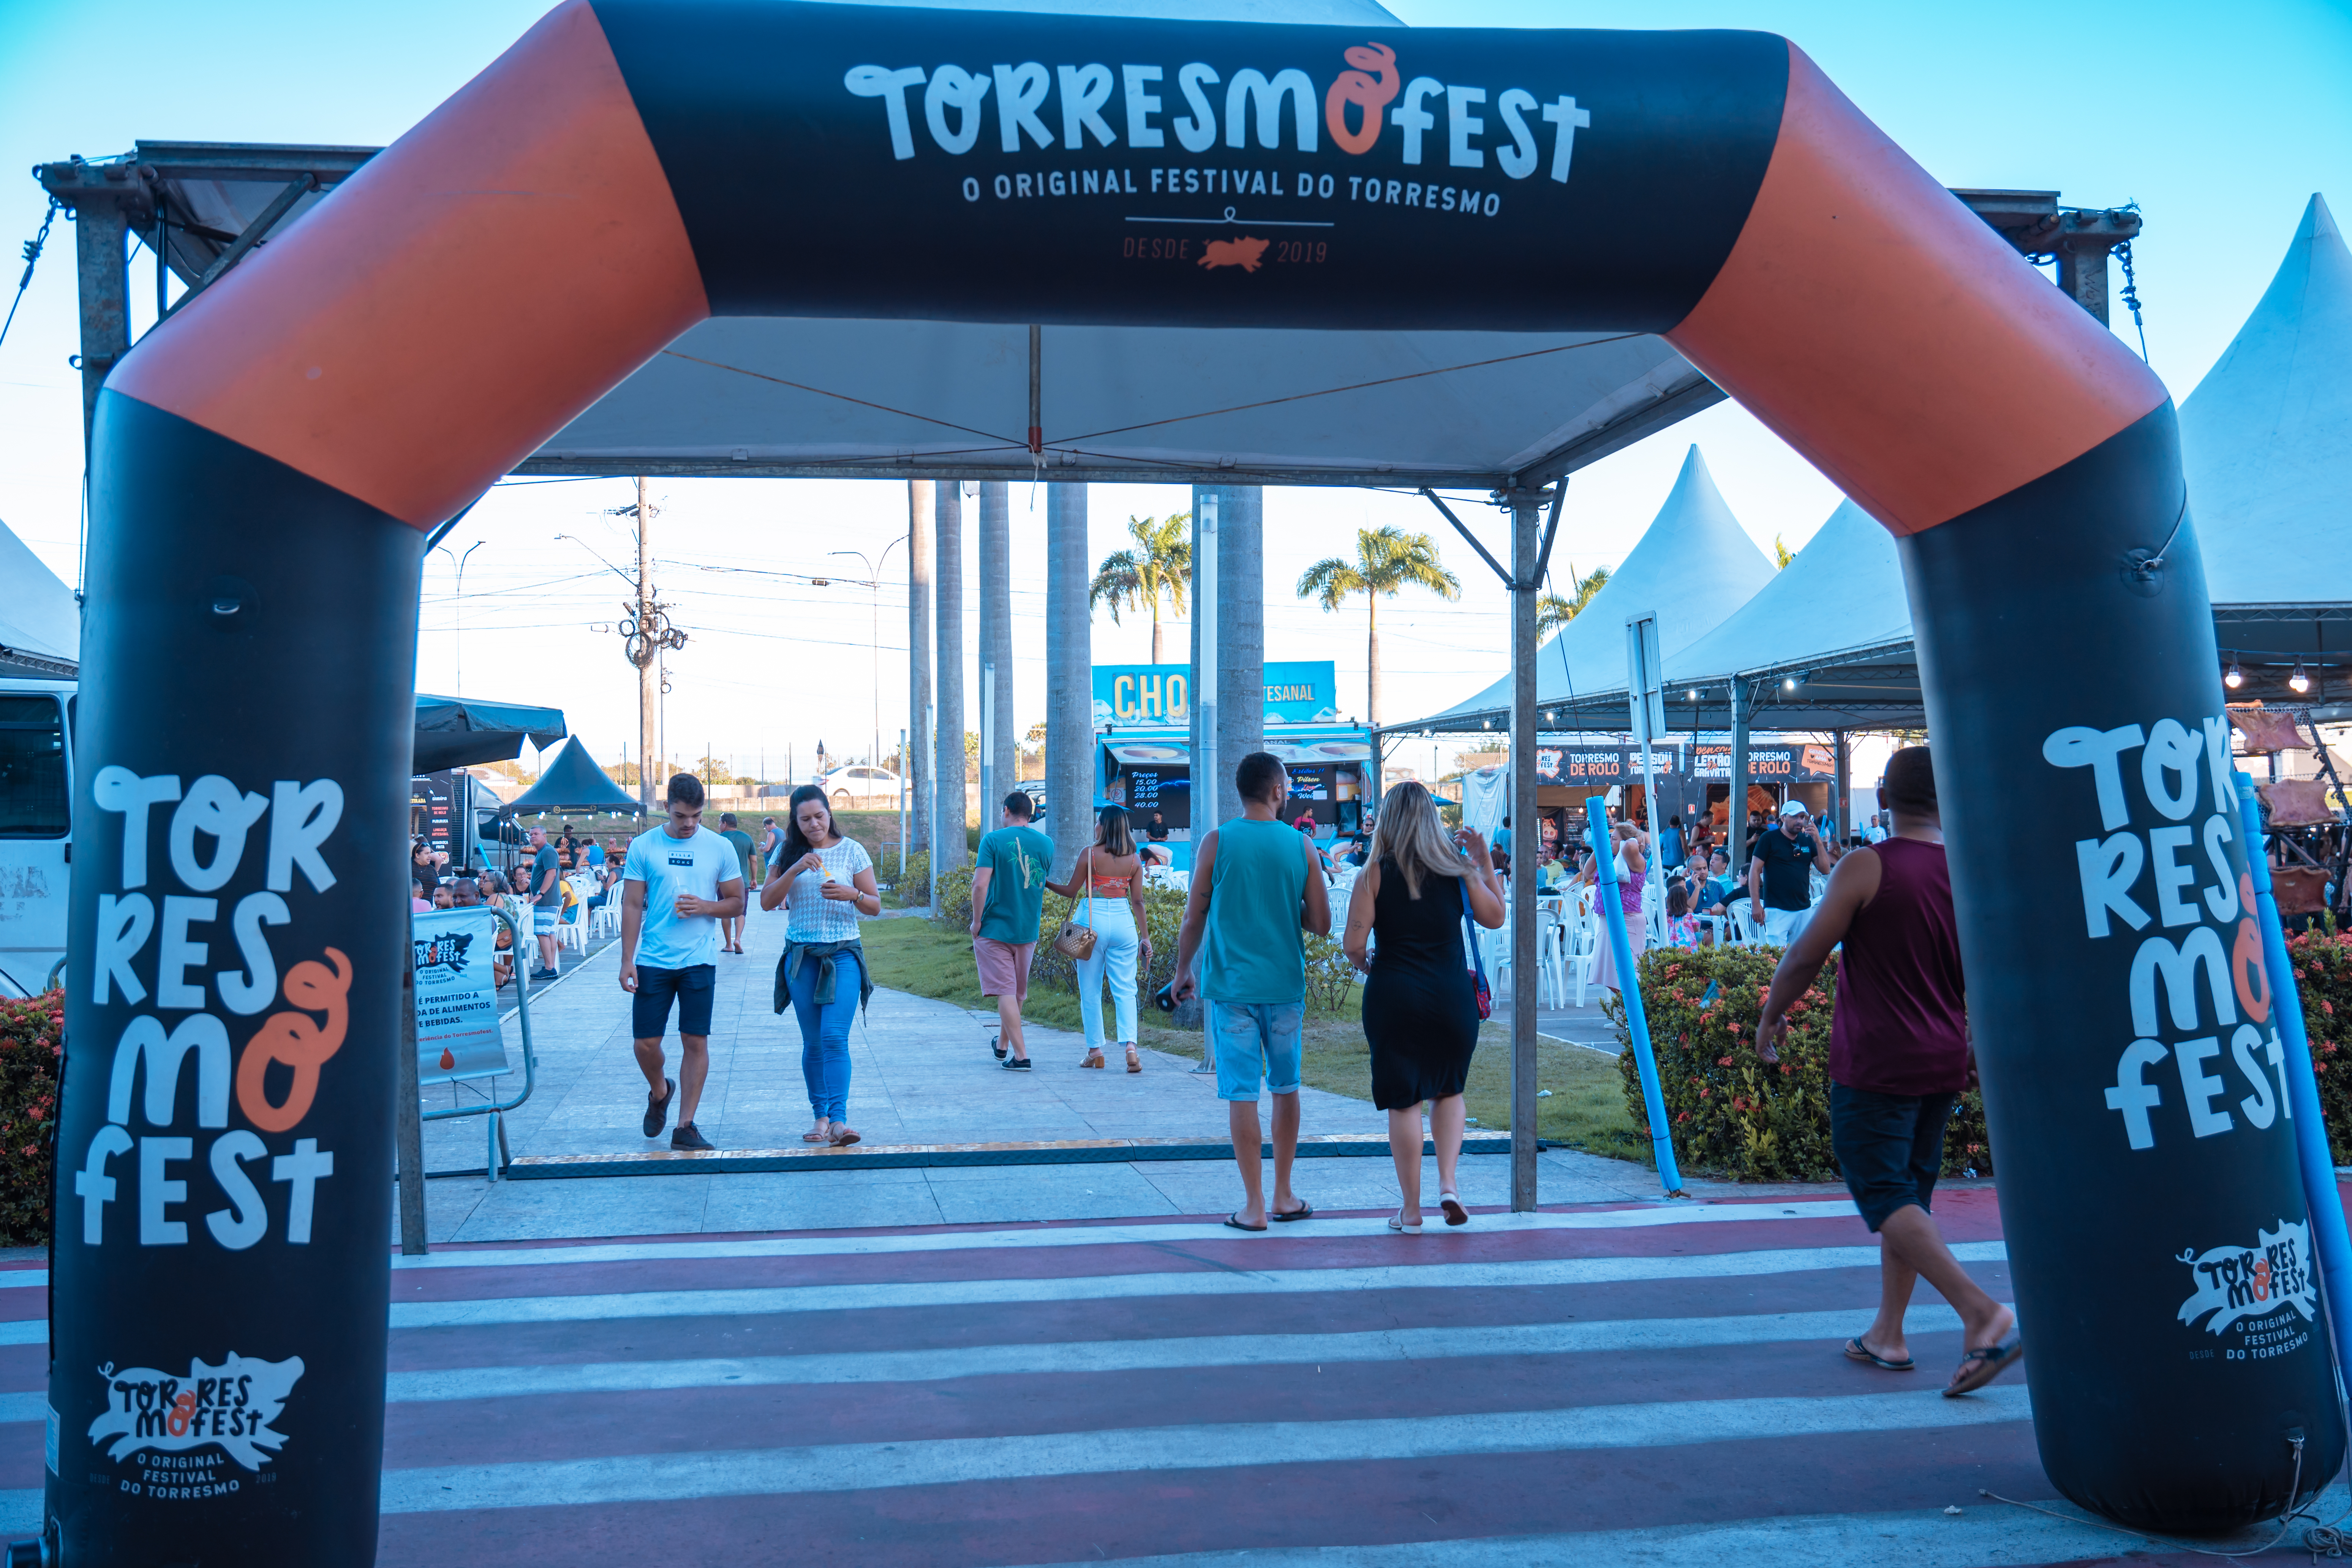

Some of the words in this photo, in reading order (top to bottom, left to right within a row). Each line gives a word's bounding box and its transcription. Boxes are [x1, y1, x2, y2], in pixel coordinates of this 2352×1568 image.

[963, 180, 980, 202] O
[995, 169, 1138, 200] ORIGINAL
[1151, 168, 1284, 195] FESTIVAL
[1298, 173, 1334, 198] DO
[1349, 177, 1501, 216] TORRESMO
[1124, 236, 1189, 261] DESDE
[1277, 241, 1327, 264] 2019
[1570, 753, 1619, 763] TORRESMO
[1629, 752, 1672, 765] PESOU
[1694, 752, 1730, 767] LEITÃO
[1748, 752, 1790, 761] ORRESMO
[1570, 763, 1585, 776] DE
[1588, 763, 1619, 776] ROLO
[1630, 760, 1672, 774] TORSMO?
[1759, 761, 1790, 774] ROLO
[2042, 714, 2239, 831] TOR
[93, 765, 345, 895] TOR
[2075, 814, 2238, 938] RES
[438, 939, 455, 952] RES
[93, 890, 292, 1015] RES
[425, 976, 455, 985] TORRESMO
[419, 996, 423, 1005] É
[425, 993, 471, 1004] PERMITIDO
[442, 1002, 490, 1013] ALIMENTOS
[425, 1017, 463, 1027] BEBIDAS.
[452, 1029, 493, 1037] Torresmofest.
[2197, 1250, 2257, 1290] TOR
[2266, 1238, 2297, 1272] RES
[2237, 1322, 2243, 1332] O
[2249, 1310, 2296, 1332] ORIGINAL
[2245, 1326, 2295, 1345] FESTIVAL
[2227, 1349, 2245, 1359] DO
[2251, 1332, 2308, 1359] TORRESMO
[2189, 1349, 2214, 1359] DESDE
[114, 1378, 178, 1412] TOR
[196, 1374, 253, 1407] RES
[137, 1453, 146, 1465] O
[152, 1453, 224, 1468] ORIGINAL
[90, 1473, 110, 1484] DESDE
[144, 1470, 216, 1483] FESTIVAL
[256, 1472, 277, 1484] 2019
[121, 1480, 141, 1494] DO
[149, 1480, 240, 1499] TORRESMO
